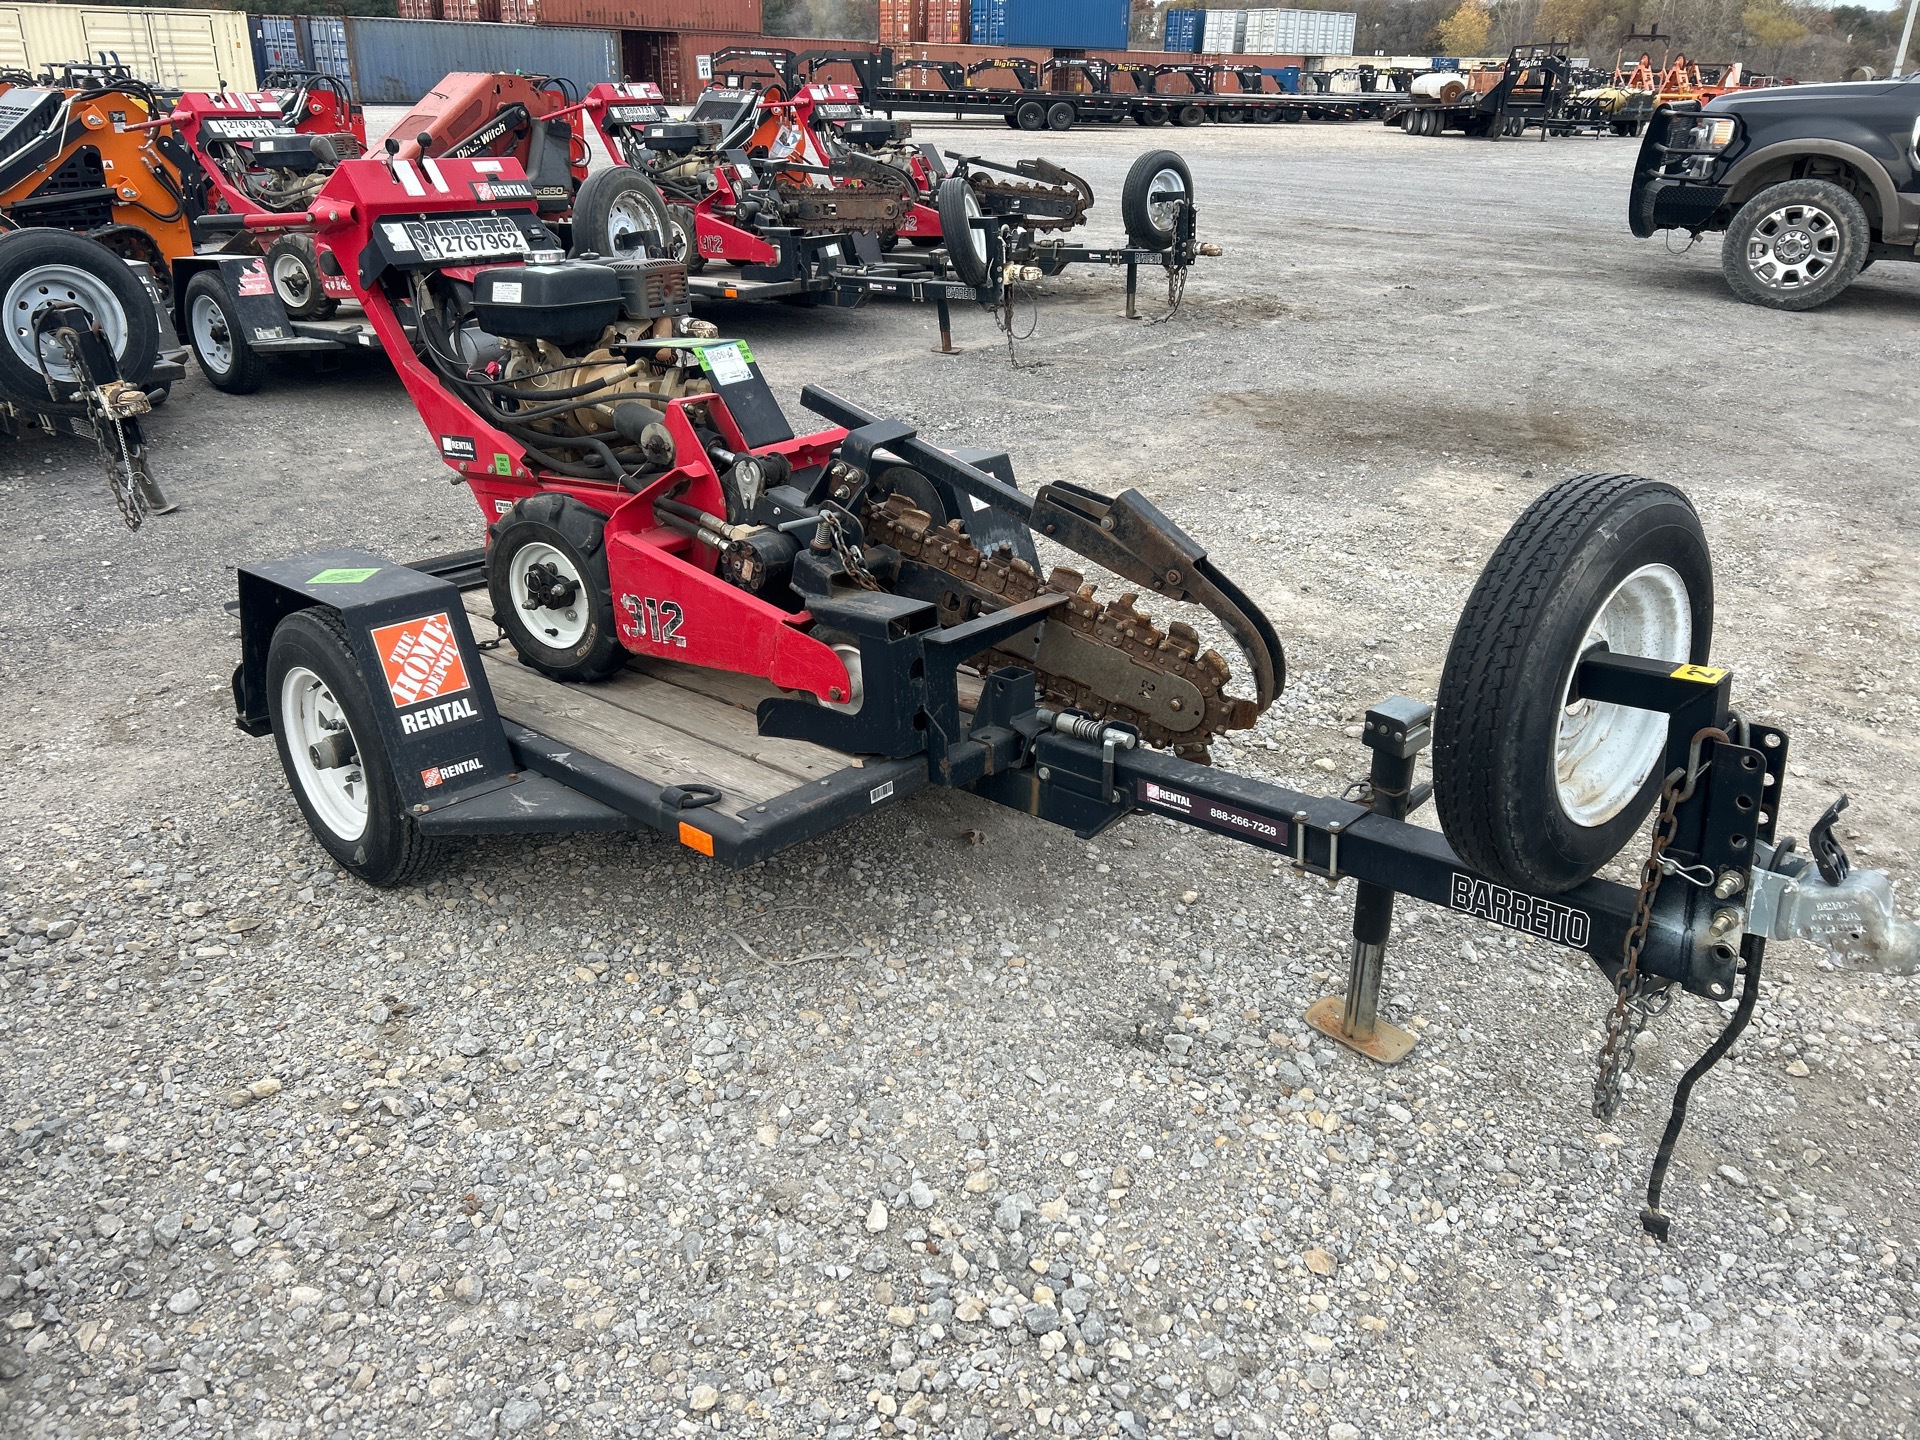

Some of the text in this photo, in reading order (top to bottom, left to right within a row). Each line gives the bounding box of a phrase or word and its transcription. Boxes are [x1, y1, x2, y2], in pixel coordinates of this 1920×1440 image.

[702, 67, 709, 76] 11
[993, 59, 1019, 68] BigTex
[1117, 63, 1141, 72] BigTex
[1519, 58, 1544, 69] BigTex
[228, 119, 269, 130] 2767932
[480, 122, 507, 145] Witch
[490, 183, 532, 198] RENTAL
[440, 232, 523, 254] 2767962
[452, 440, 474, 451] RENTAL
[388, 630, 418, 665] THE
[391, 615, 452, 703] HOME
[422, 640, 459, 697] DEPOT
[400, 697, 478, 735] RENTAL
[439, 757, 484, 780] RENTAL
[1159, 789, 1277, 837] RENTAL 888-266-7228
[1450, 872, 1591, 949] BARRETO
